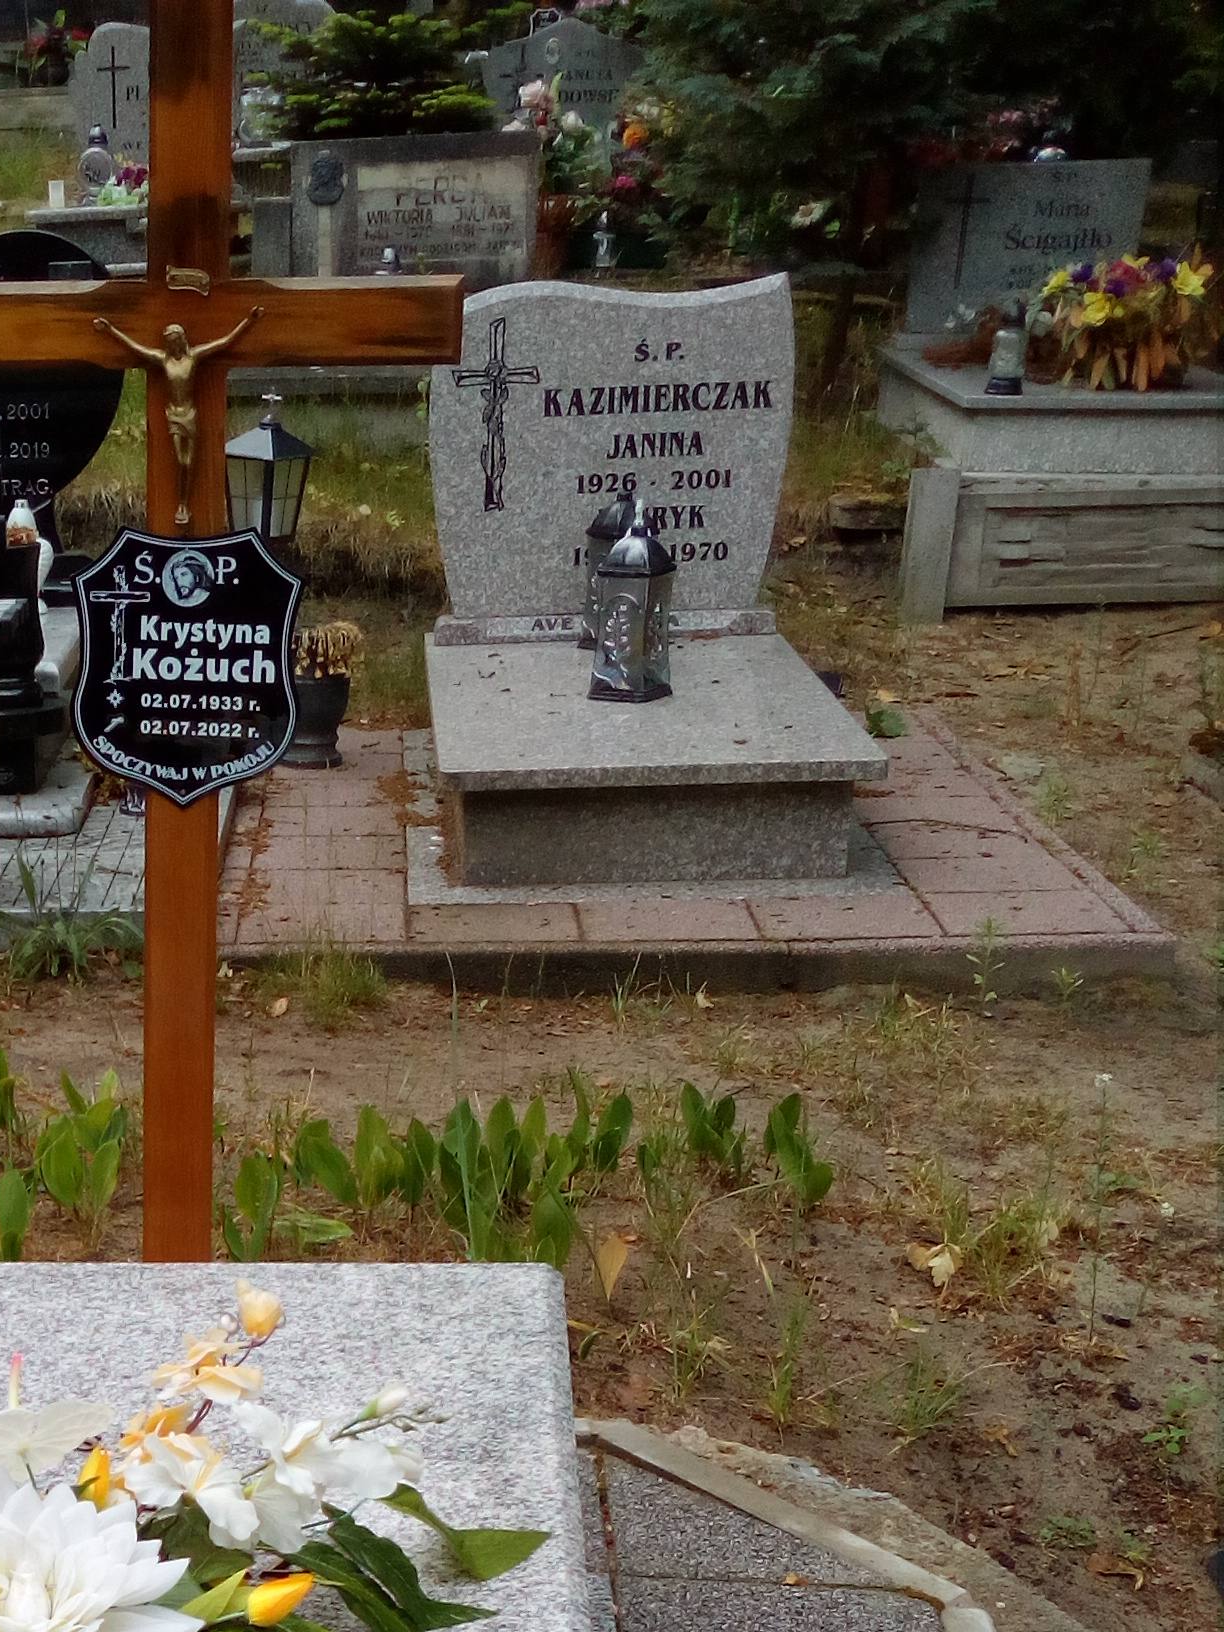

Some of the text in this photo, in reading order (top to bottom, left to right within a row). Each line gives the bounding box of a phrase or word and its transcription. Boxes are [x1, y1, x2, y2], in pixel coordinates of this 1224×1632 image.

[1033, 200, 1090, 218] Maria
[543, 380, 773, 418] KAZIMIERCZAK
[606, 431, 704, 460] JANINA
[577, 472, 638, 494] 1926
[671, 469, 732, 491] 2001
[646, 505, 705, 530] RYK
[670, 541, 729, 563] 1970
[140, 615, 271, 650] Krystyna
[531, 616, 574, 631] AVE
[132, 648, 275, 683] Kożuch
[140, 693, 261, 711] 02.07.1933 r.
[140, 720, 260, 739] 02.07.2022 r.
[93, 735, 275, 781] SPOCZYWAJ W POKOJU
